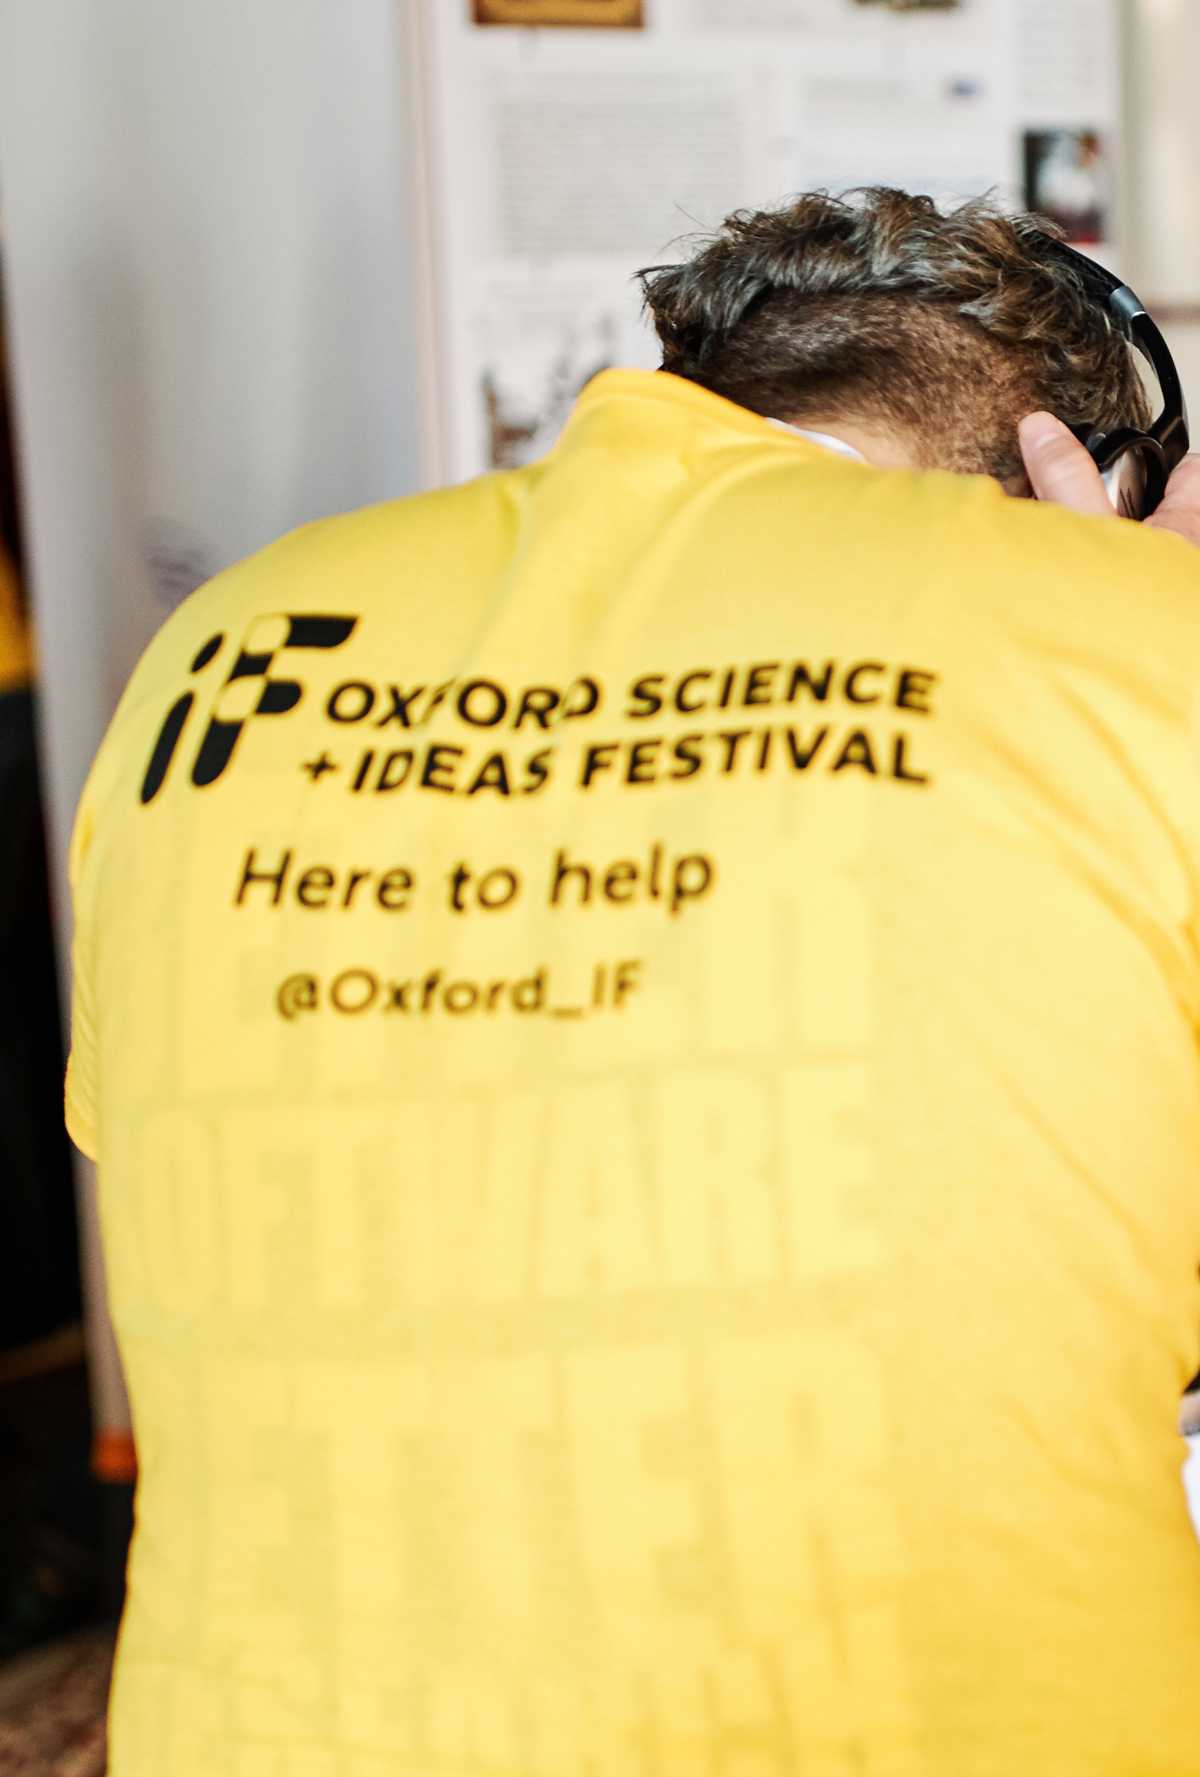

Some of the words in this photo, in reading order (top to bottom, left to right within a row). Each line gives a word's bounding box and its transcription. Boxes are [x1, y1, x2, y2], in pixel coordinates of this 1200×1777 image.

[626, 660, 936, 719] SCIENCE
[351, 742, 553, 798] IDEAS
[579, 727, 930, 790] FESTIVAL
[233, 847, 415, 912] Here
[449, 861, 519, 914] to
[549, 843, 715, 915] help
[274, 960, 642, 1022] @Oxford_IF
